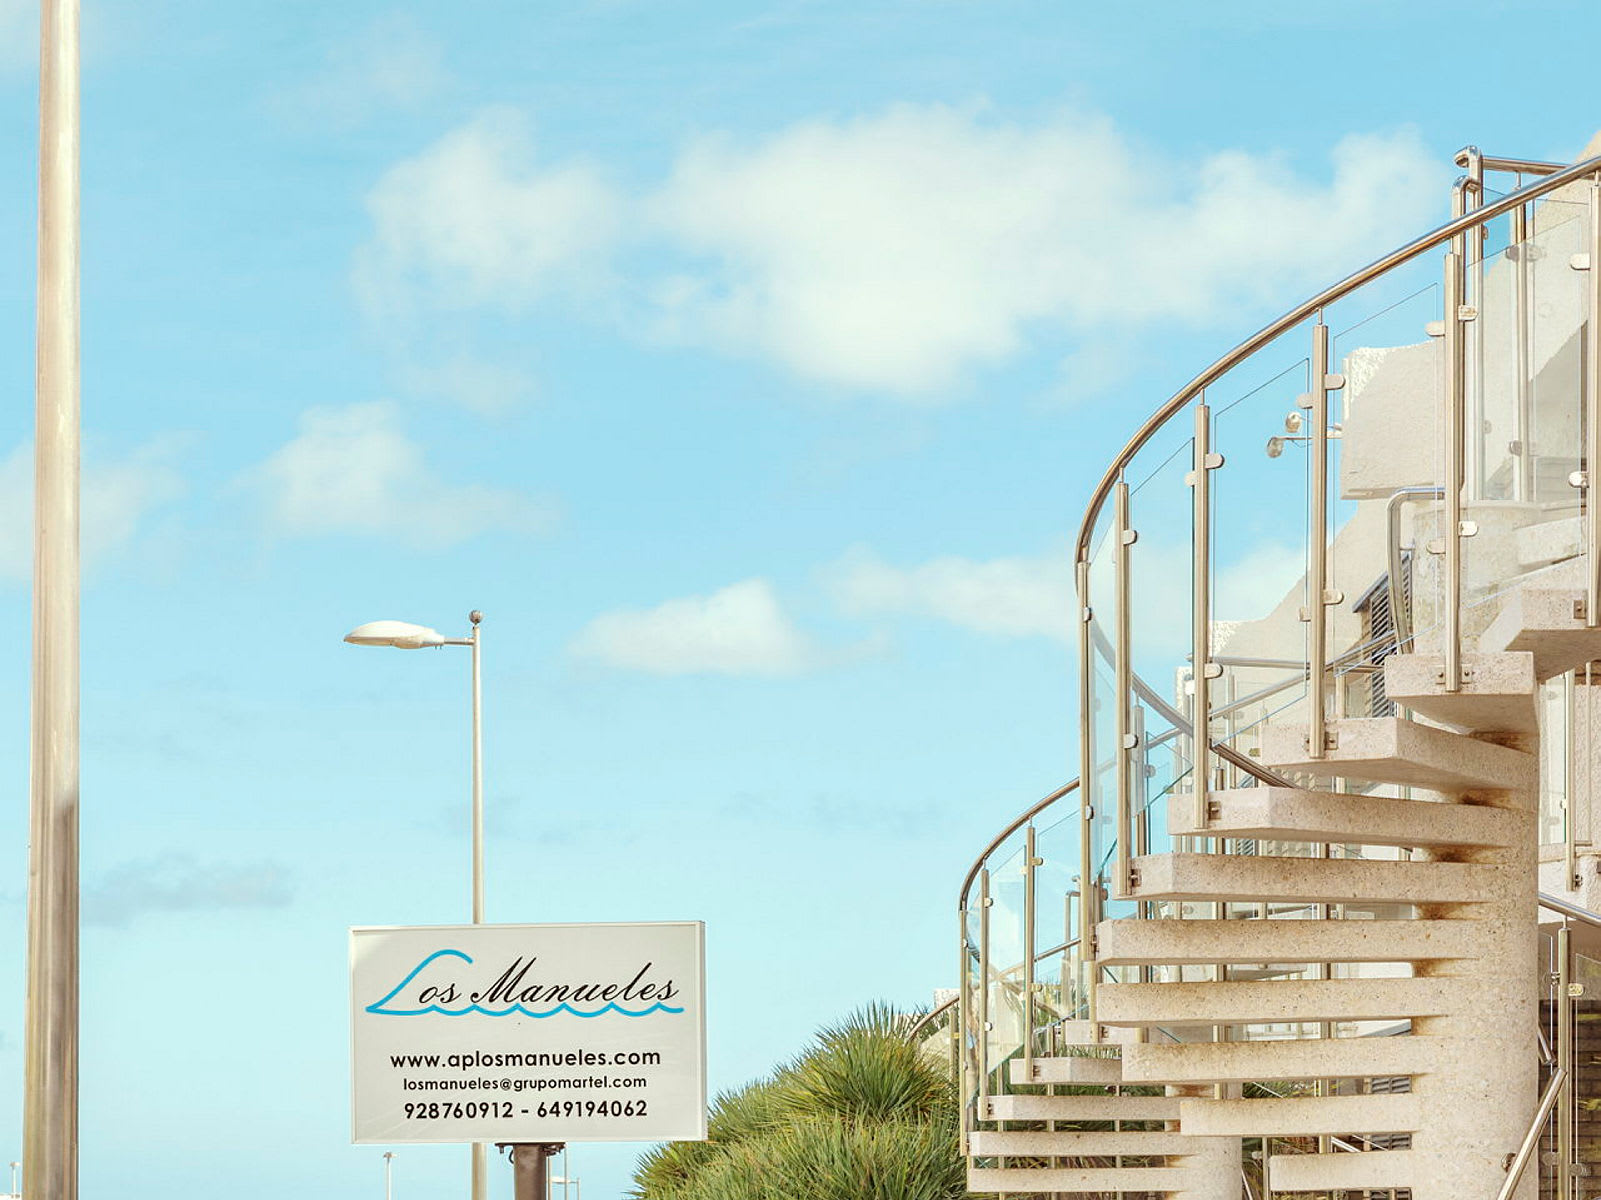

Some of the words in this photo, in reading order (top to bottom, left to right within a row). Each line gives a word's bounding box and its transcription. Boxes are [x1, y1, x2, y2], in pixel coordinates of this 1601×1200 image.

[364, 948, 473, 1016] Los
[469, 956, 679, 1004] Manueles
[390, 1048, 661, 1072] www.aplosmanueles.com
[403, 1075, 648, 1093] losmanueles@grupomartel.com
[404, 1101, 514, 1120] 928760912
[537, 1099, 648, 1118] 649194062
